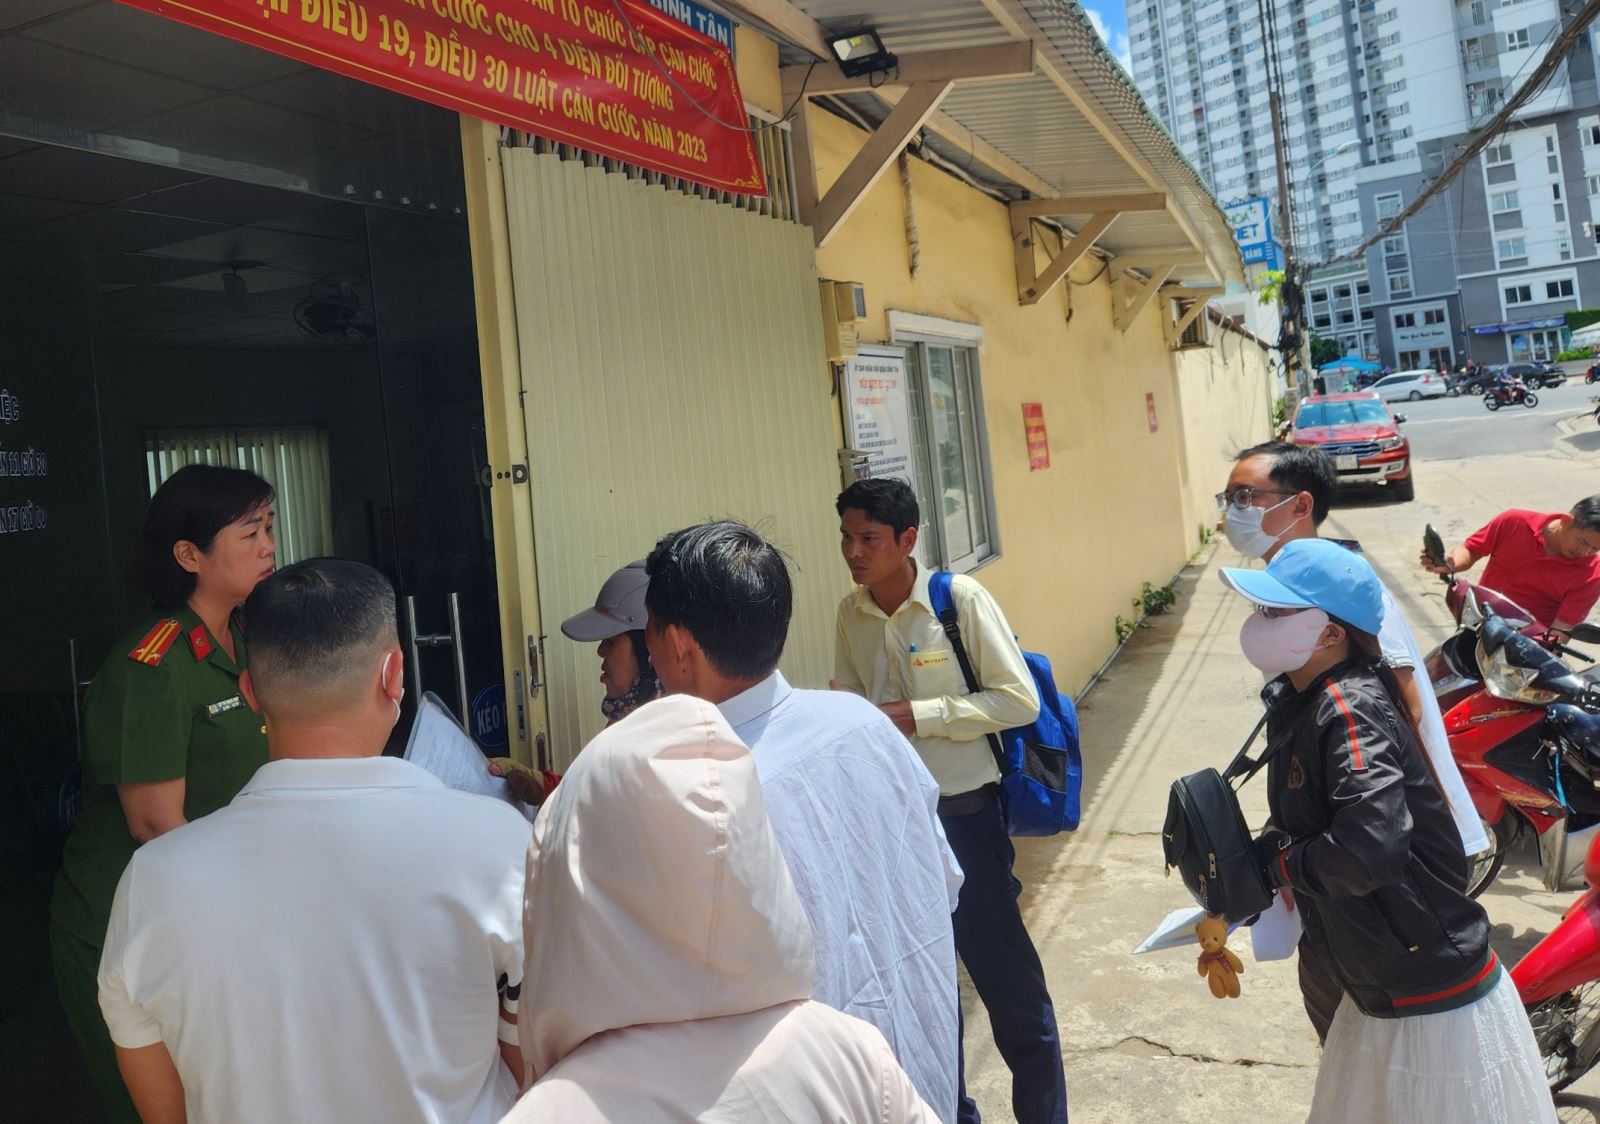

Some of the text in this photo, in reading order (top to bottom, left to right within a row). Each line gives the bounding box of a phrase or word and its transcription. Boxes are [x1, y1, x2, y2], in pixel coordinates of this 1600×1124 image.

[495, 12, 540, 53] CHO
[543, 32, 557, 60] 4
[557, 38, 601, 80] DIỆN
[604, 53, 629, 92] ĐỐI
[632, 67, 674, 112] TƯỢNG
[584, 6, 626, 47] CHỨC
[659, 41, 686, 75] CĂN
[688, 54, 717, 90] CƯỚC
[696, 11, 728, 46] TÂN
[379, 14, 416, 68] 19,
[424, 29, 477, 82] ĐIỀU
[483, 54, 509, 93] 30
[513, 66, 558, 115] LUẬT
[562, 86, 595, 126] CĂN
[598, 102, 640, 141] CƯỚC
[641, 116, 675, 152] NĂM
[677, 130, 708, 163] 2023
[477, 701, 500, 736] KÉO
